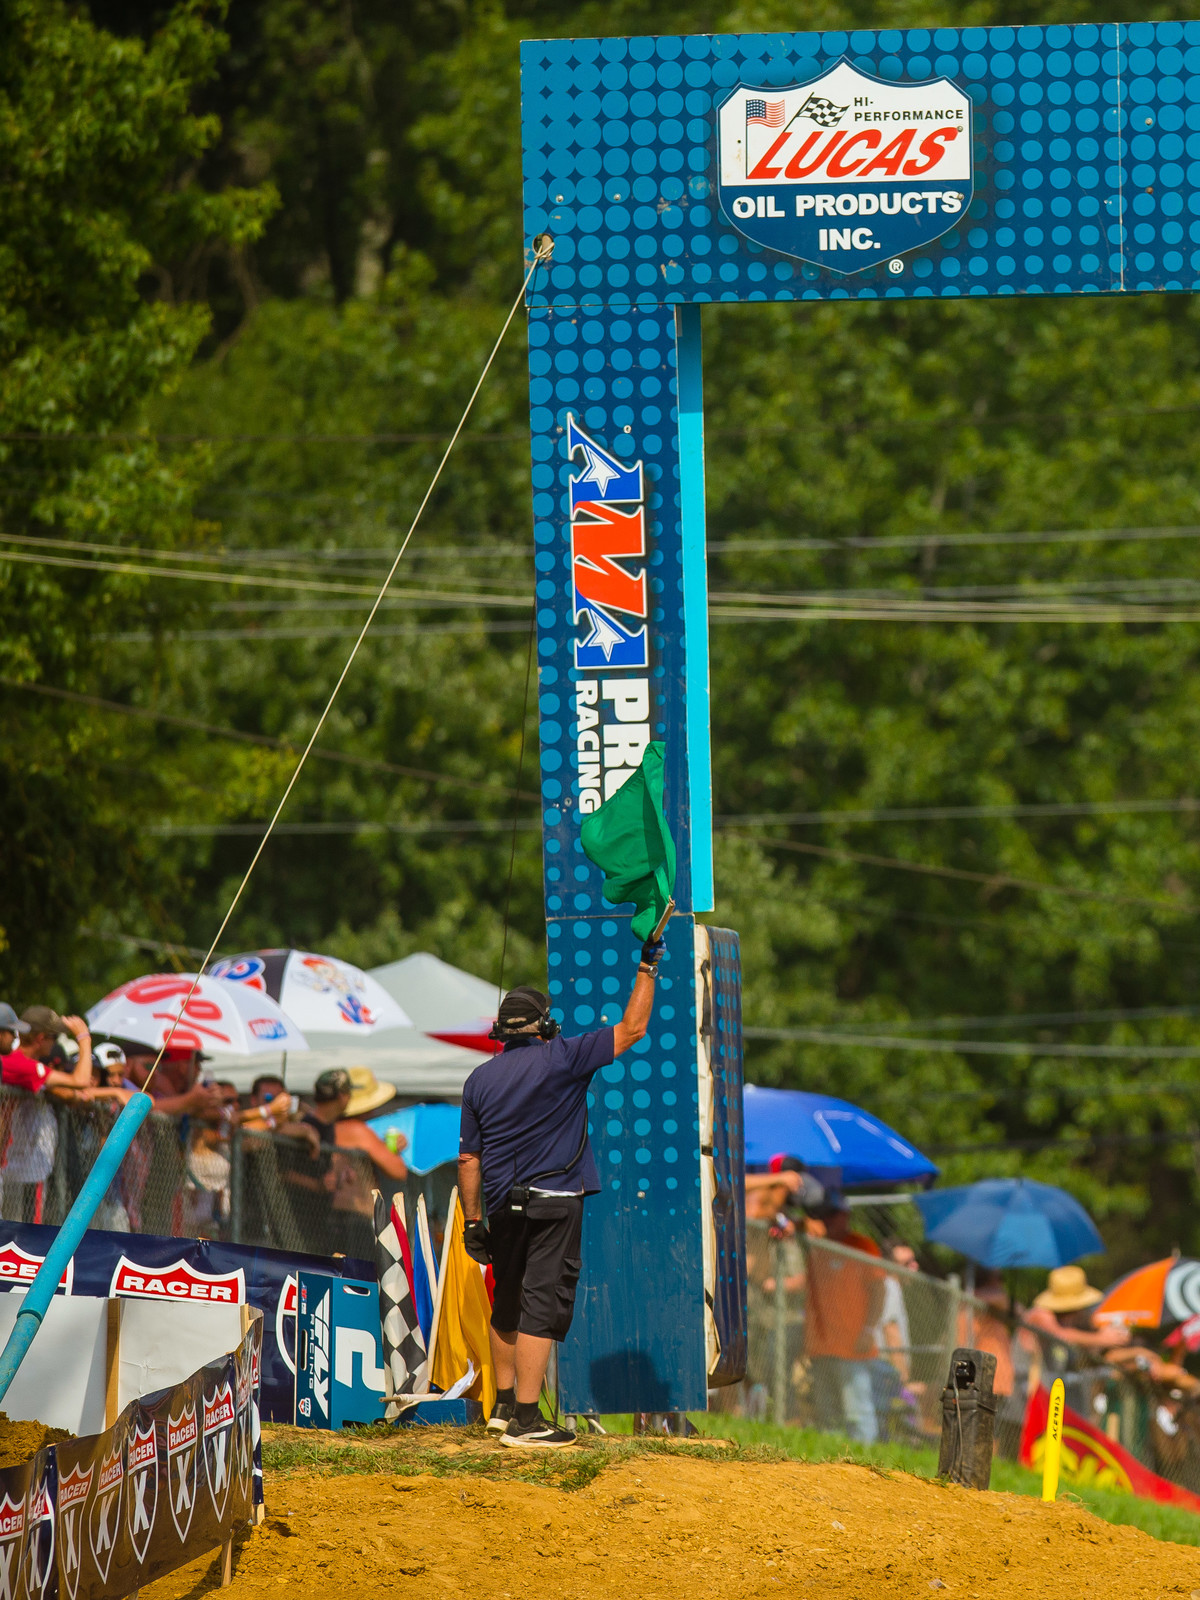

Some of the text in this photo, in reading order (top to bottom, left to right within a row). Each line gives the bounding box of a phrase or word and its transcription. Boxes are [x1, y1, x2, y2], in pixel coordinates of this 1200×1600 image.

[854, 97, 873, 107] HI-
[854, 110, 964, 122] PERFORMANCE
[747, 127, 958, 180] LUCAS
[733, 191, 962, 219] OIL PRODUCTS
[819, 228, 881, 251] INC.
[567, 412, 648, 668] AMA
[576, 680, 601, 814] RACING
[122, 1275, 233, 1300] RACER
[170, 1422, 195, 1448] RACER
[206, 1403, 231, 1428] RACER
[176, 1451, 192, 1515] X
[212, 1431, 227, 1495] X
[96, 1491, 115, 1555] X
[134, 1470, 150, 1534] X
[65, 1508, 78, 1574] X
